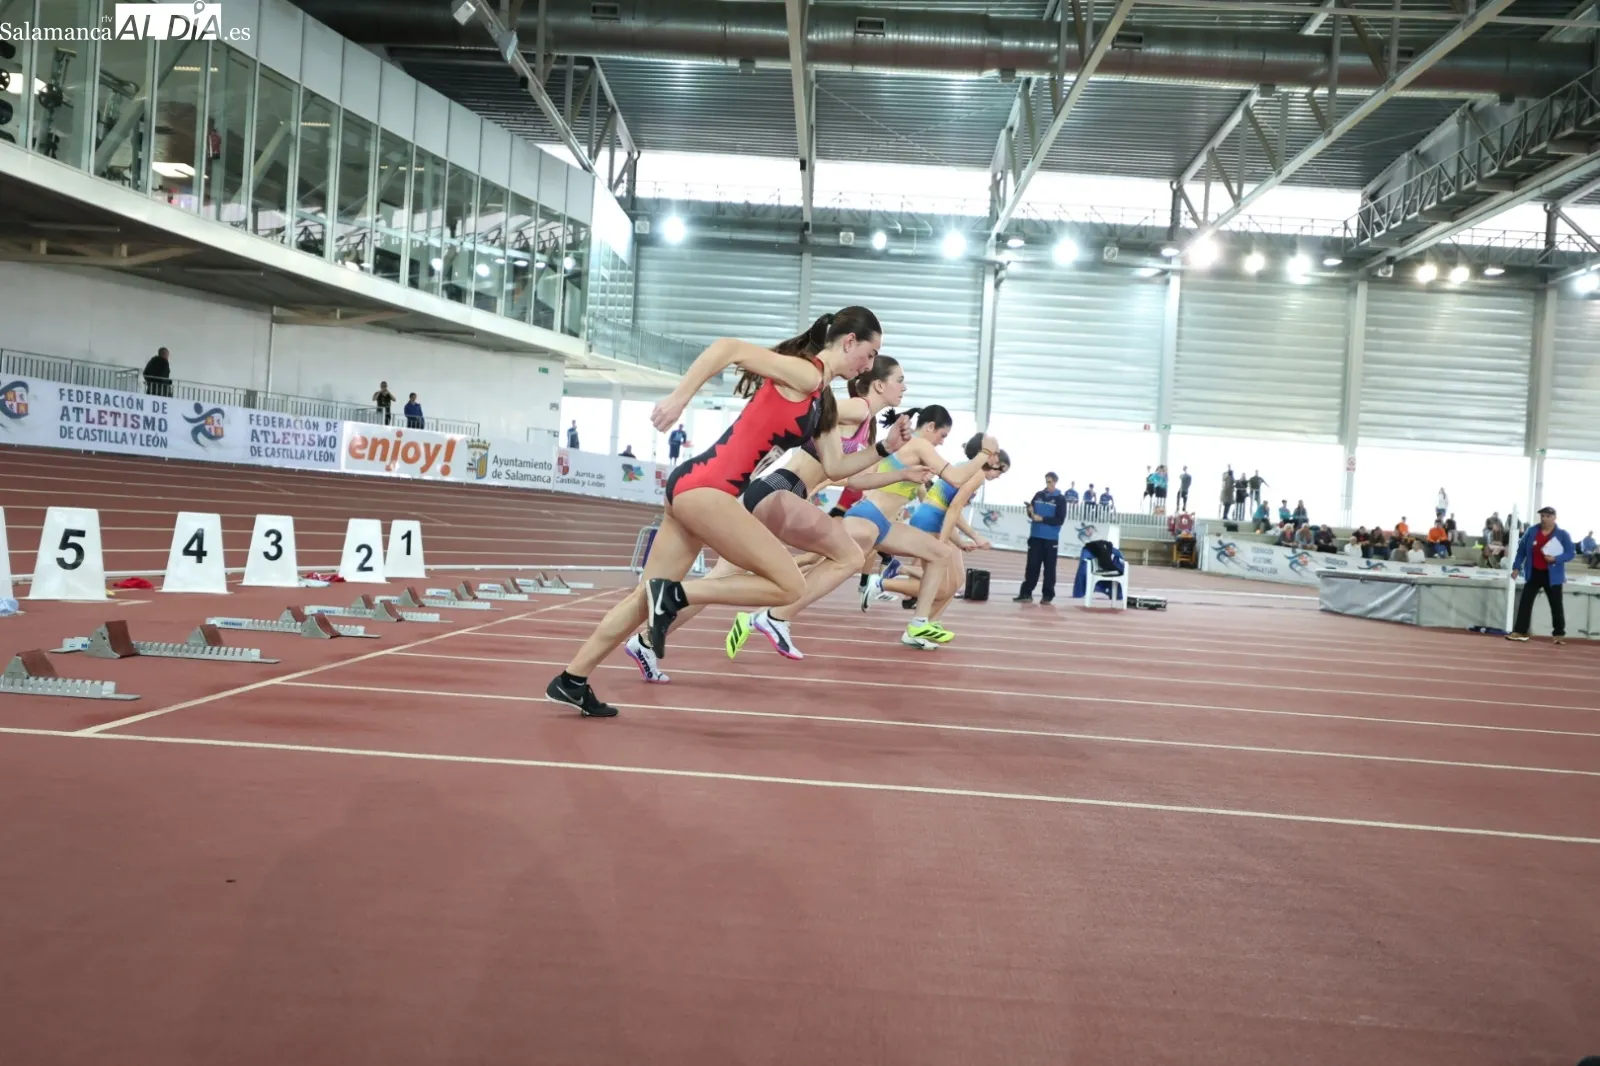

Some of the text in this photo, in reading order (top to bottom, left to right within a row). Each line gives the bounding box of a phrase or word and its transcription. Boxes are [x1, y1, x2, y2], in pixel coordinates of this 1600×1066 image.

[59, 388, 168, 414] FEDERACIÓN DE
[60, 405, 168, 433] ATLETISMO
[249, 413, 338, 433] FEDERACIÓN DE
[59, 425, 168, 449] DE CASTILLA Y LEÓN
[250, 428, 337, 449] ATLETISMO
[250, 445, 336, 462] DE CASTILLA Y LEÓN
[349, 430, 457, 476] enjoy!
[492, 454, 552, 471] Ayuntamiento
[492, 468, 551, 484] de Salamanca
[575, 470, 595, 480] Junta
[56, 528, 86, 570] 5
[182, 528, 207, 564] 4
[263, 529, 283, 561] 3
[401, 530, 412, 556] 1
[355, 544, 374, 572] 2
